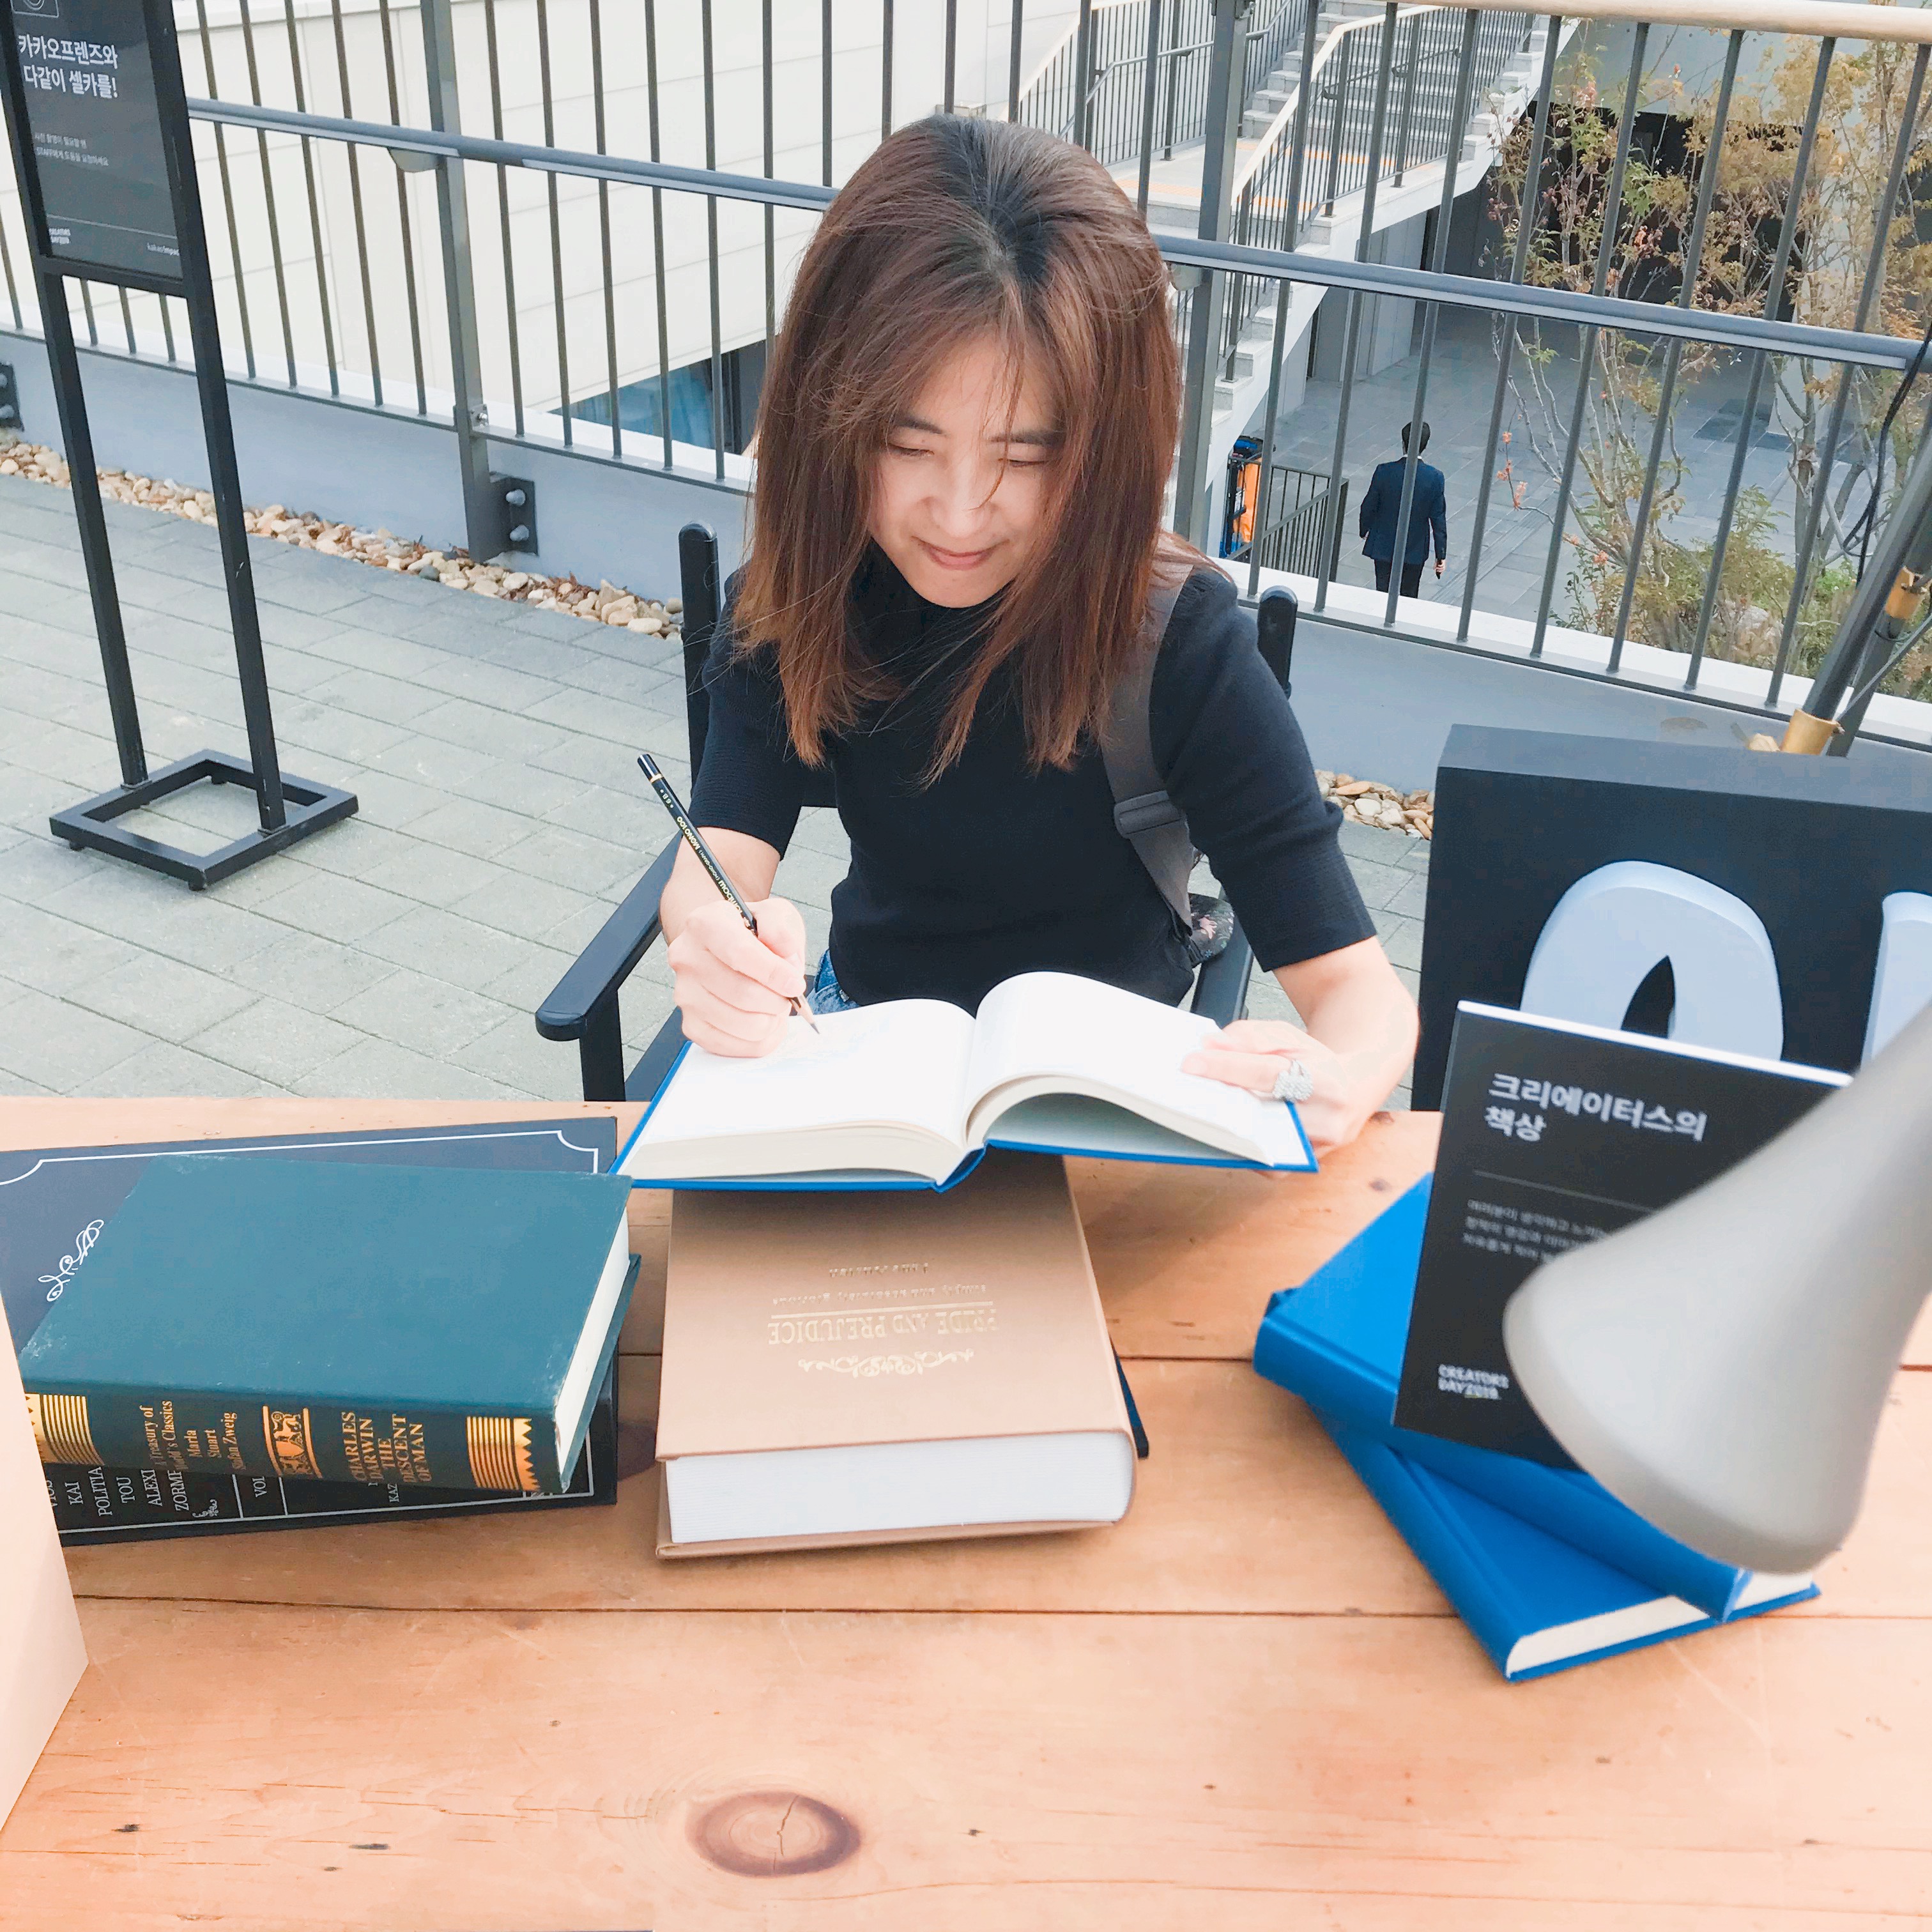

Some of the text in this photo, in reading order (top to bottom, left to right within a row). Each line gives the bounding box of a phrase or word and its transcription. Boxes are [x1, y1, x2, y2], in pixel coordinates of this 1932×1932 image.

[18, 34, 119, 70] 카카오프렌즈와
[23, 65, 118, 99] 다같이 셀카를!
[1484, 1105, 1547, 1142] 책상
[1489, 1073, 1708, 1142] 크리에이터스의
[767, 1308, 998, 1345] PRIDE AND PREJUDICE
[139, 1405, 154, 1418] of
[160, 1400, 176, 1441] Classics
[220, 1412, 238, 1445] Zweig
[144, 1420, 164, 1460] Treasury
[204, 1429, 222, 1458] Stuart
[342, 1411, 369, 1482] CHARLES
[359, 1418, 383, 1480] DARWIN
[378, 1438, 395, 1468] THE
[392, 1414, 417, 1483] DESCENT
[410, 1423, 433, 1482] OF MAN
[65, 1481, 84, 1505] KAI
[88, 1466, 112, 1517] POLITIA
[116, 1476, 135, 1503] TOU
